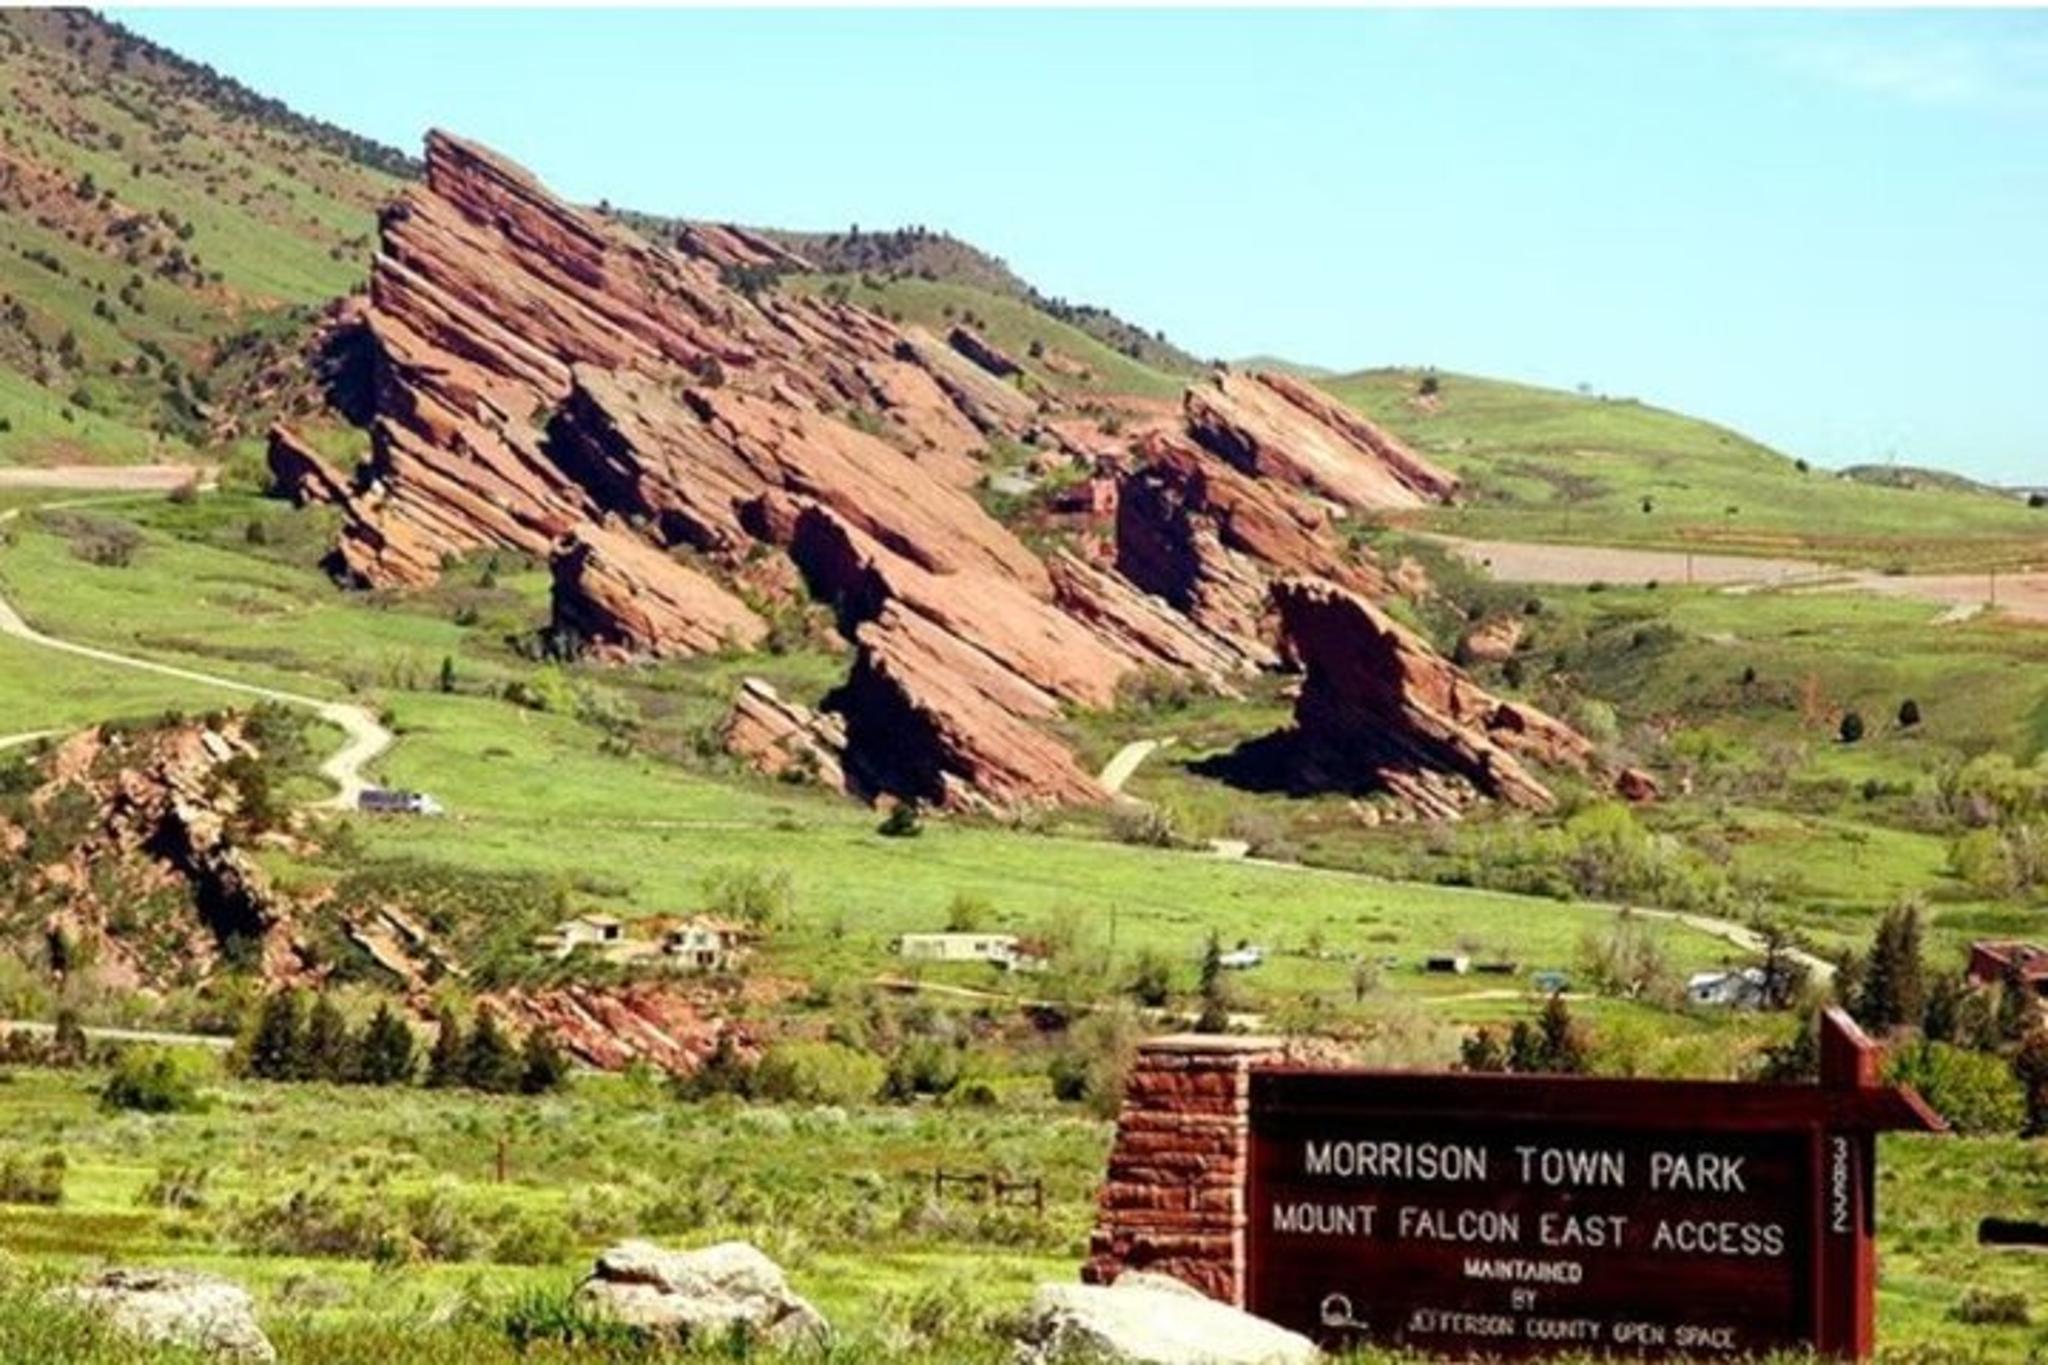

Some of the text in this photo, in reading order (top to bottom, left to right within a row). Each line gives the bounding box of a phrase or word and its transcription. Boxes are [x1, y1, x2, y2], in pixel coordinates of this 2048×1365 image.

[1306, 1141, 1745, 1192] MORRISON TOWN PARK
[1273, 1202, 1784, 1256] MOUNT FALCON EAST ACCESS
[1464, 1258, 1583, 1284] MAINTAINED
[1511, 1288, 1537, 1310] BY
[1408, 1309, 1736, 1350] JEFFERSON COUNTY OPEN SPACE
